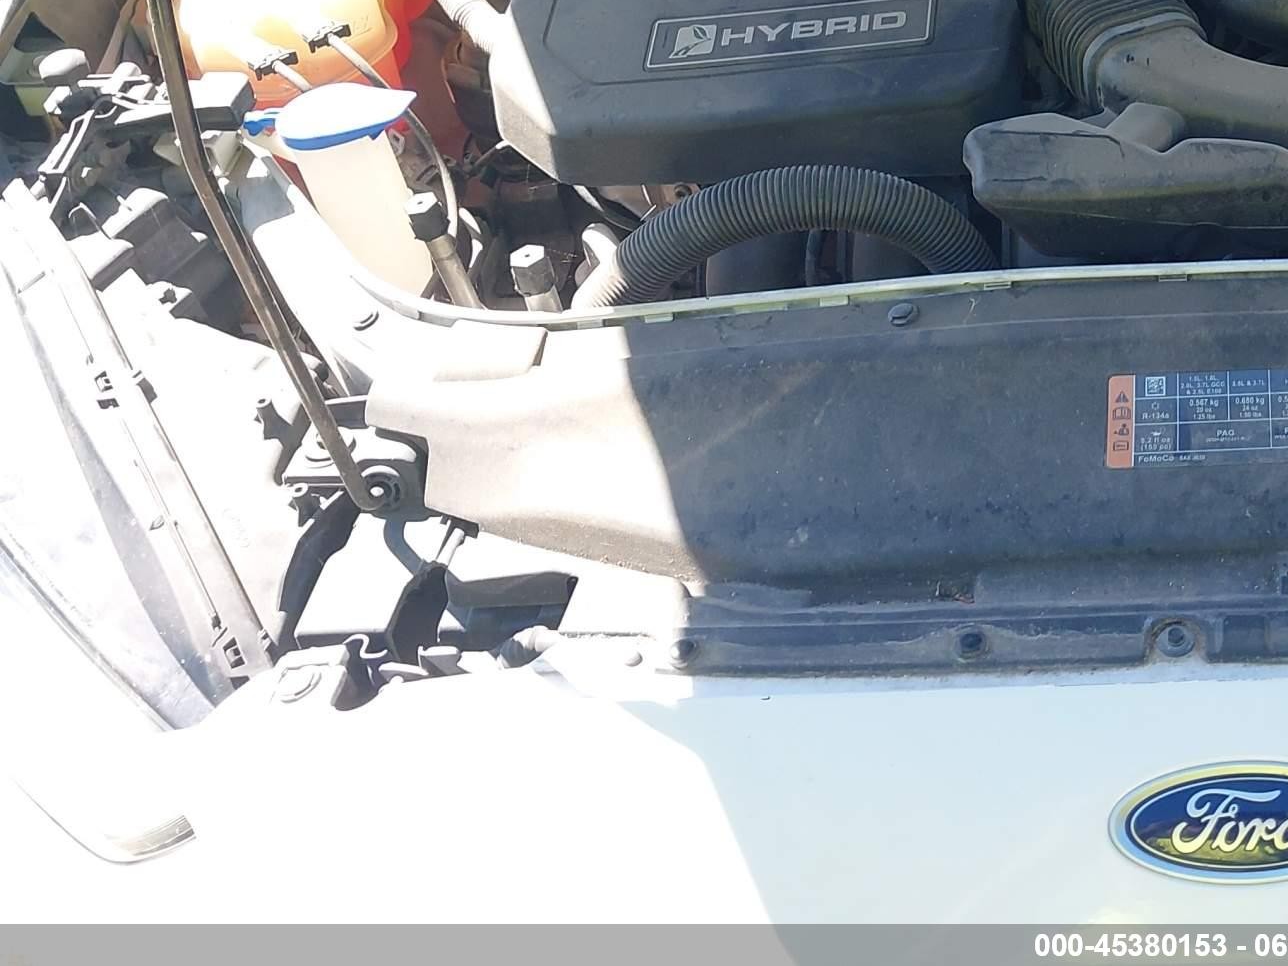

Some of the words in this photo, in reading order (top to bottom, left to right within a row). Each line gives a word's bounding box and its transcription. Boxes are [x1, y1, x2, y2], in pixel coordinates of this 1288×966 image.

[721, 11, 906, 46] HYBRID
[1210, 398, 1219, 407] kg
[1256, 396, 1265, 405] kg
[1142, 412, 1170, 420] R-134a
[1138, 454, 1174, 463] FoMoCo
